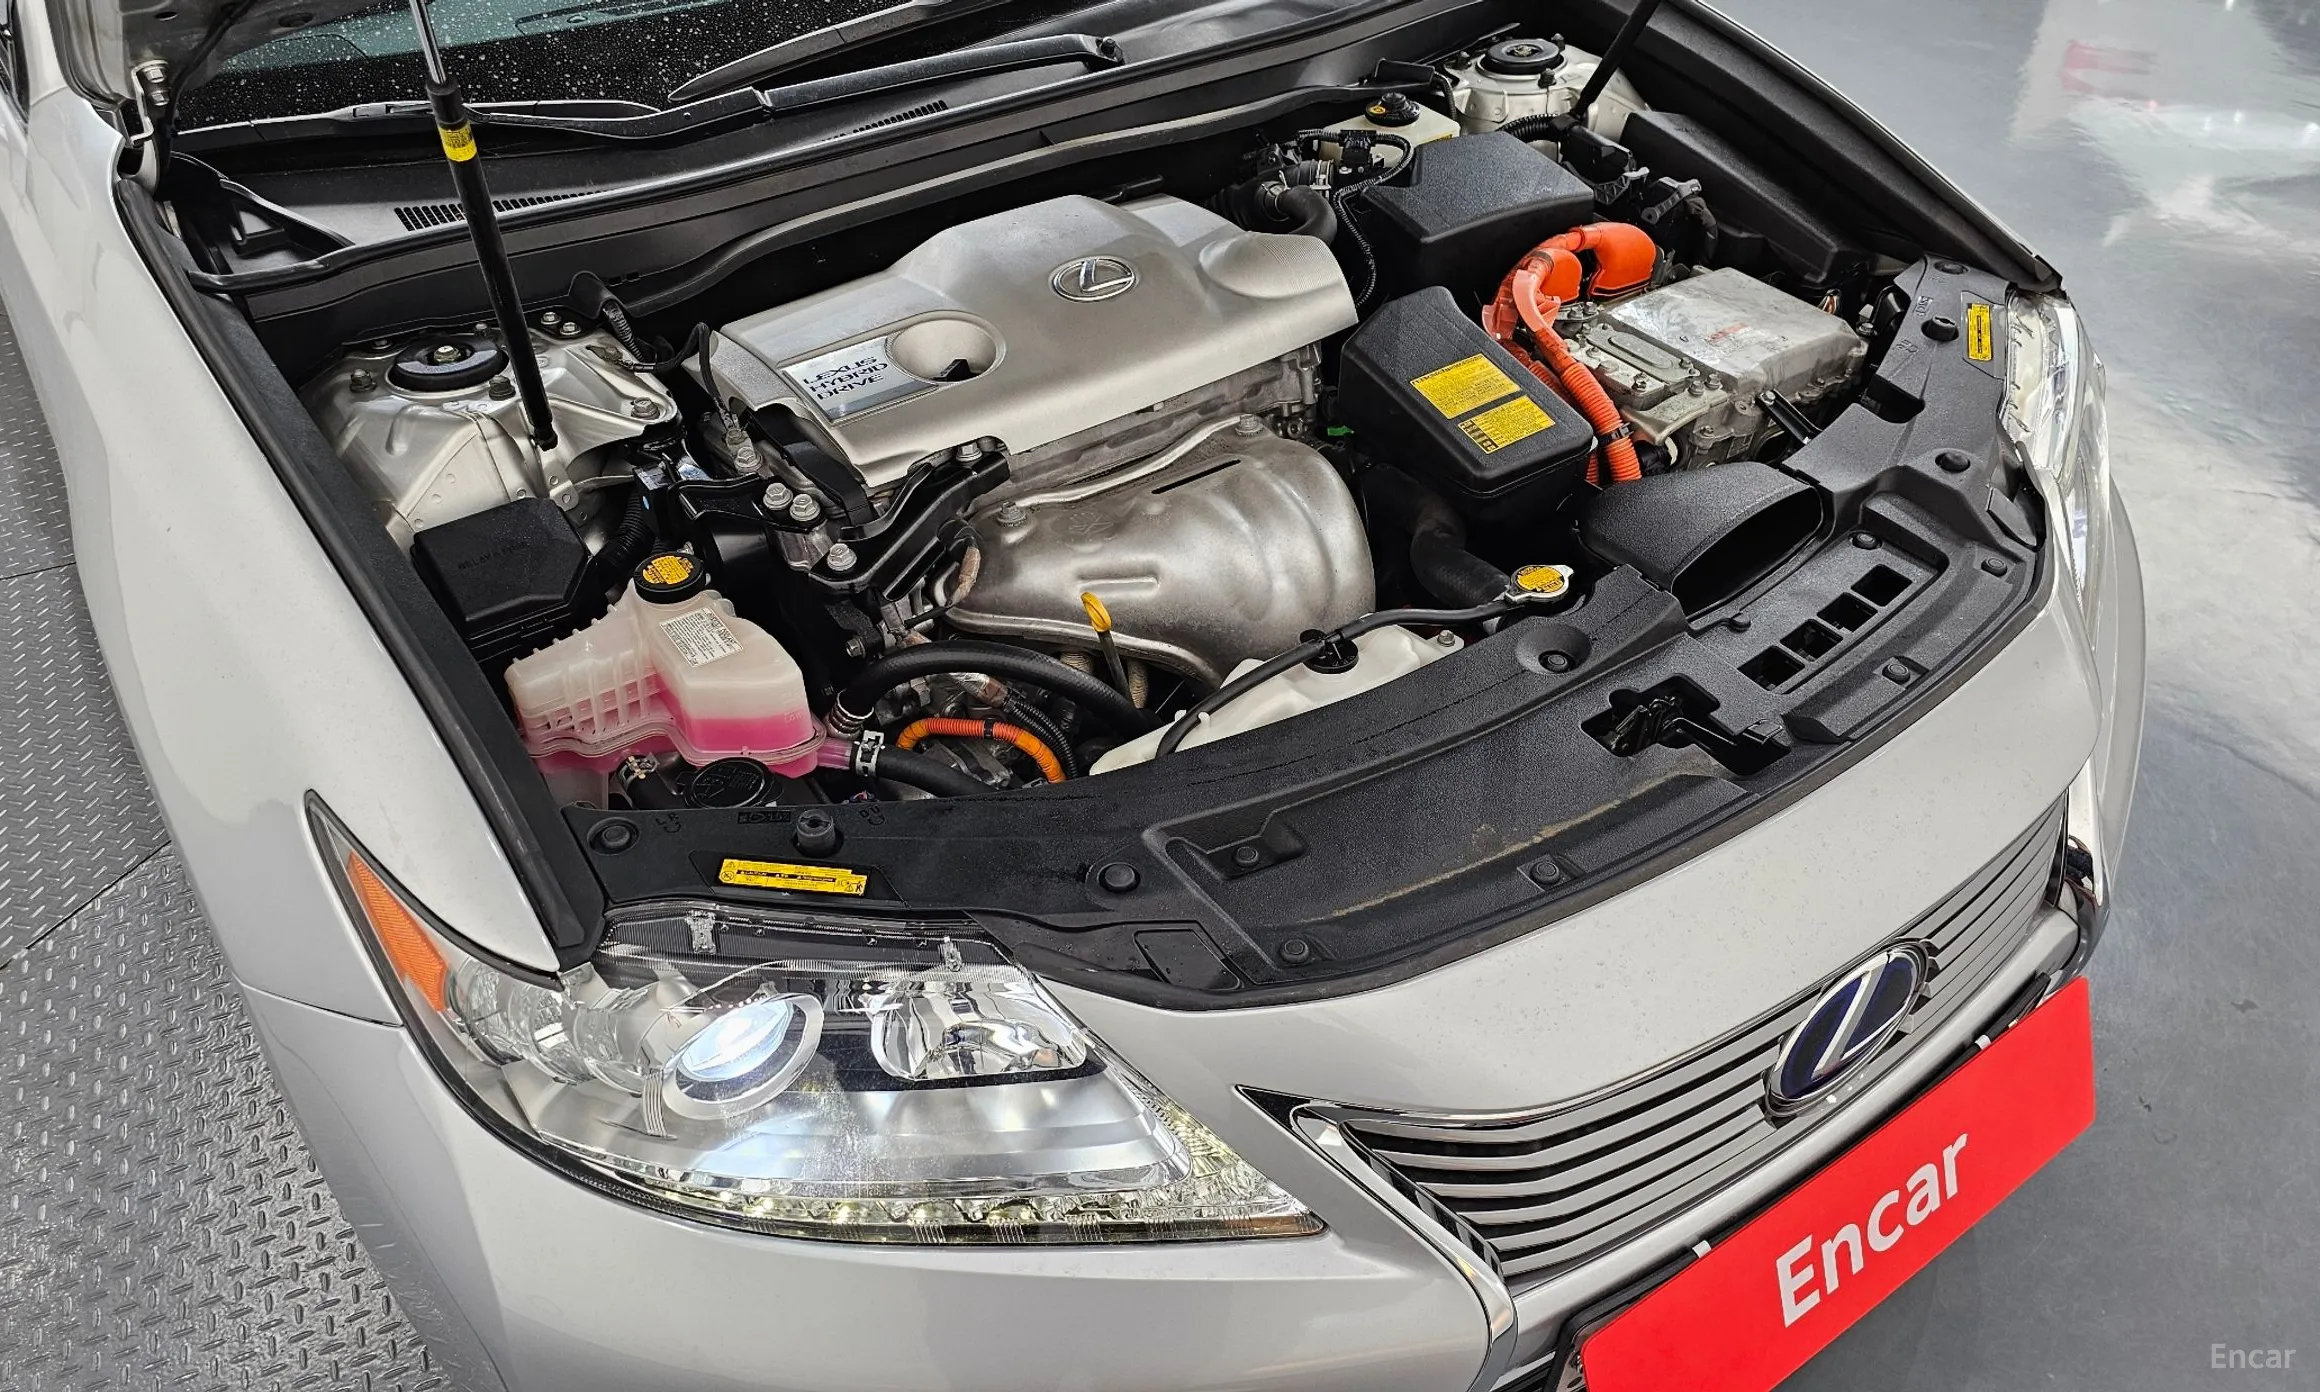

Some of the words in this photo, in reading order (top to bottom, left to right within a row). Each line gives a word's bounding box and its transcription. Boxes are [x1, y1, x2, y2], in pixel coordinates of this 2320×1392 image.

[803, 356, 877, 384] LEXUS
[809, 363, 888, 392] HYBRID
[817, 374, 884, 400] DRIVE
[1776, 1133, 1968, 1328] Encar
